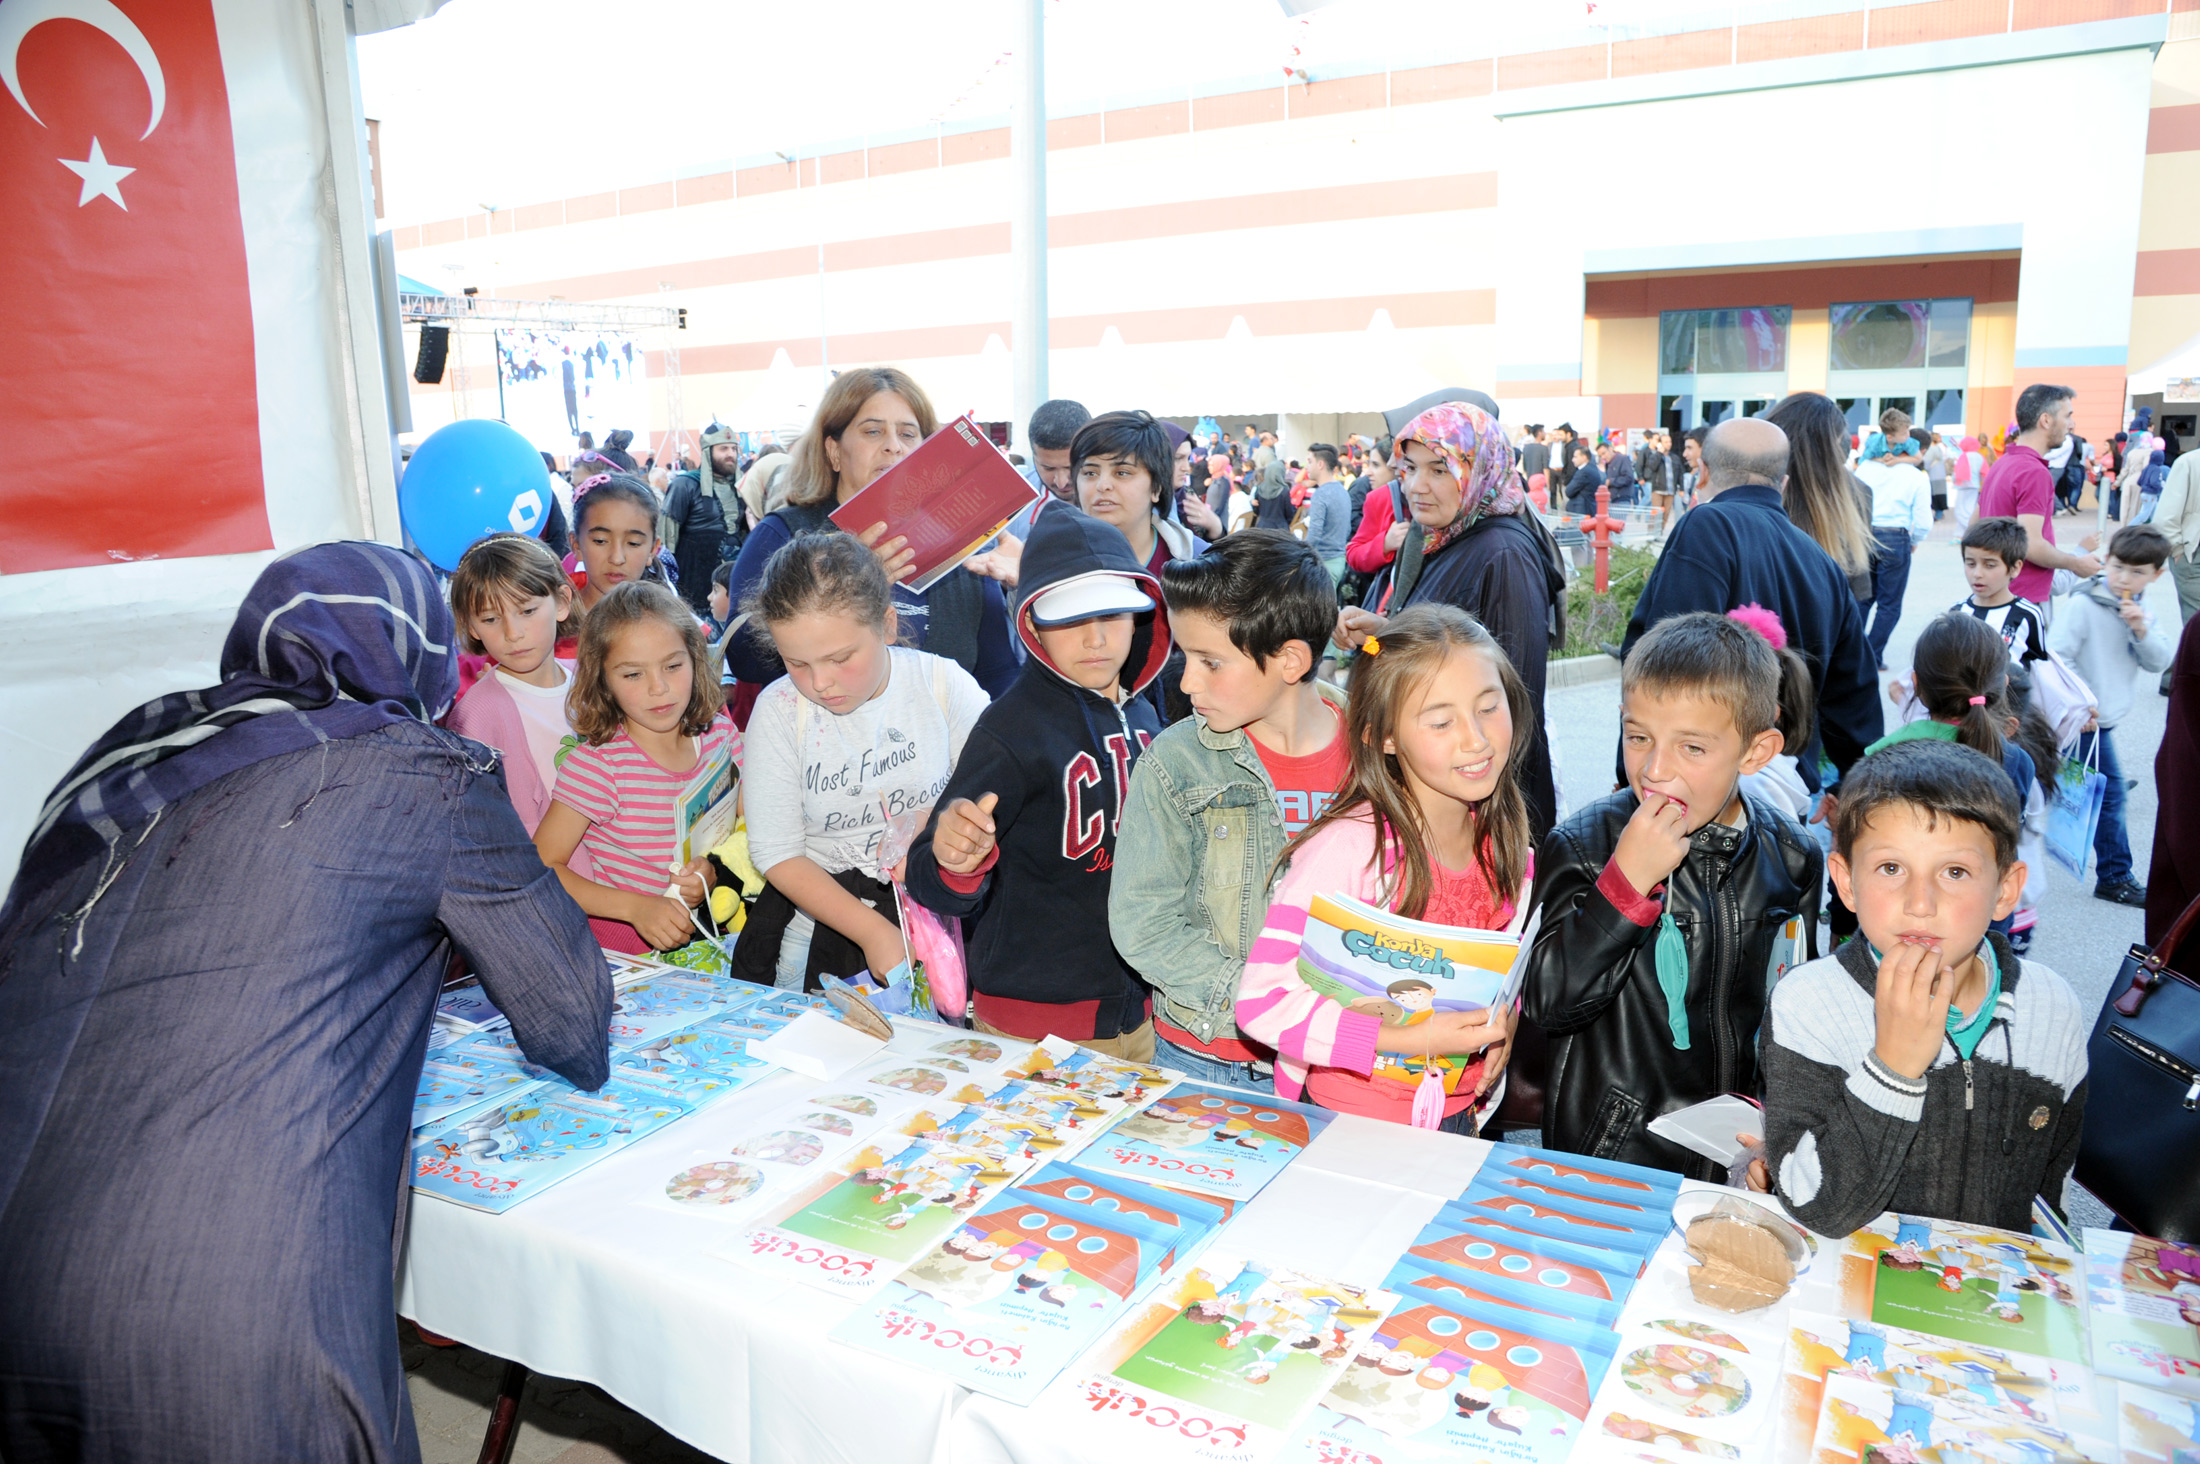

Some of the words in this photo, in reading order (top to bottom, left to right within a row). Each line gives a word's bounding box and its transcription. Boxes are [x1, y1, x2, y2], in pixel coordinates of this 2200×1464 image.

[806, 762, 849, 794] Most
[860, 741, 916, 783] Famous
[888, 766, 955, 817] Becaus
[824, 803, 874, 832] Rich
[1374, 931, 1437, 960] Konya
